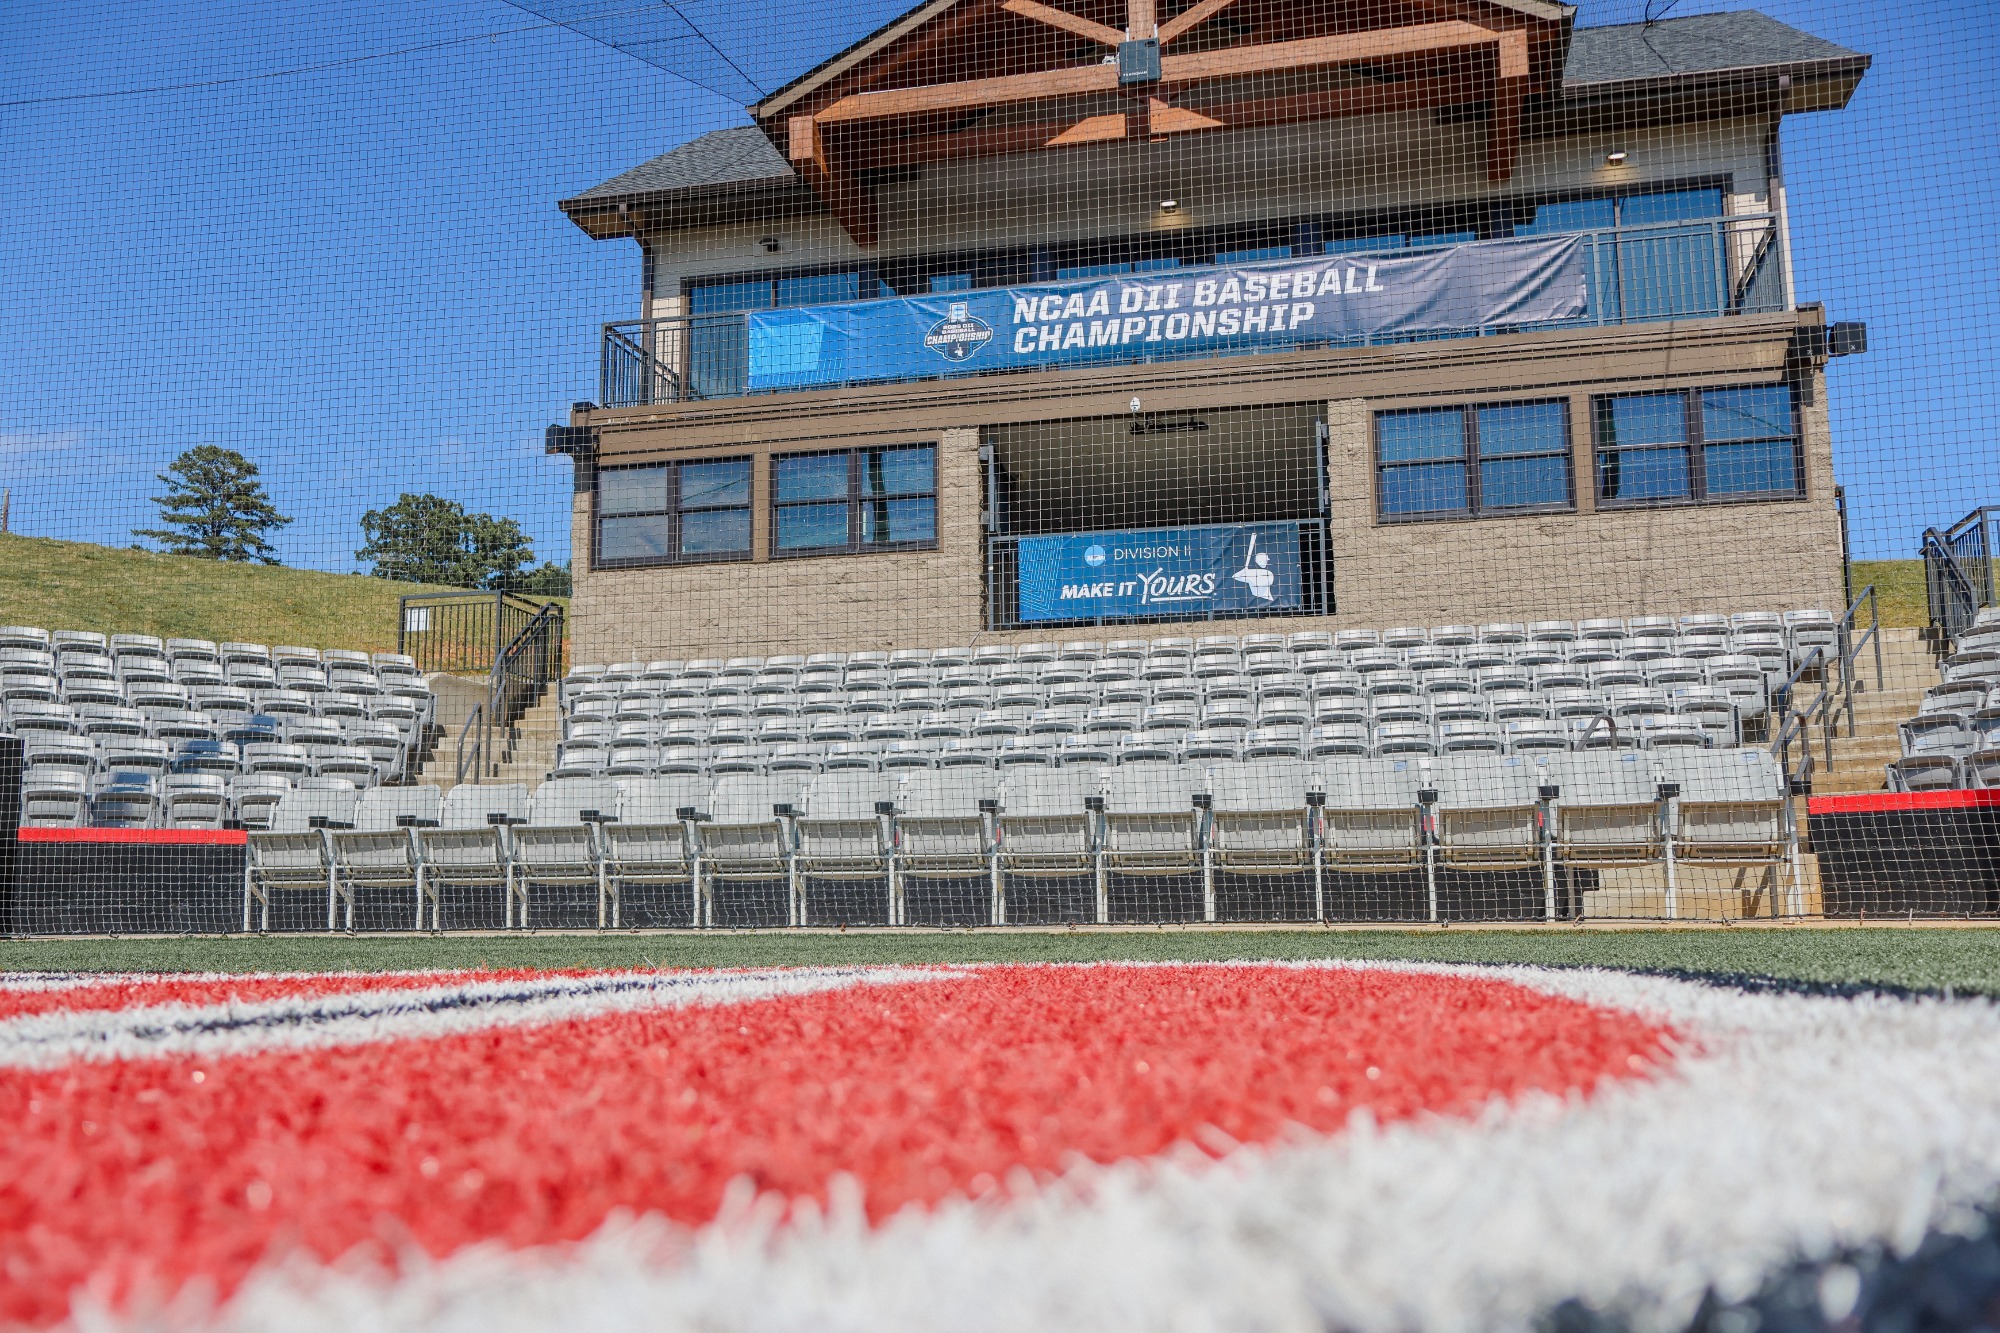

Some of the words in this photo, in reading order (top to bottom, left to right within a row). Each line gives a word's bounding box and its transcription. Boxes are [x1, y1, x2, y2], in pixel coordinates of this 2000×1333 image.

[1013, 289, 1110, 324] NCAA
[1118, 283, 1181, 314] DII
[1195, 265, 1384, 307] BASEBALL
[1013, 301, 1315, 354] CHAMPIONSHIP
[927, 331, 990, 344] CHAMPIONSHIP
[1114, 545, 1179, 560] DIVISION
[1060, 583, 1114, 599] MAKE
[1118, 581, 1137, 596] IT
